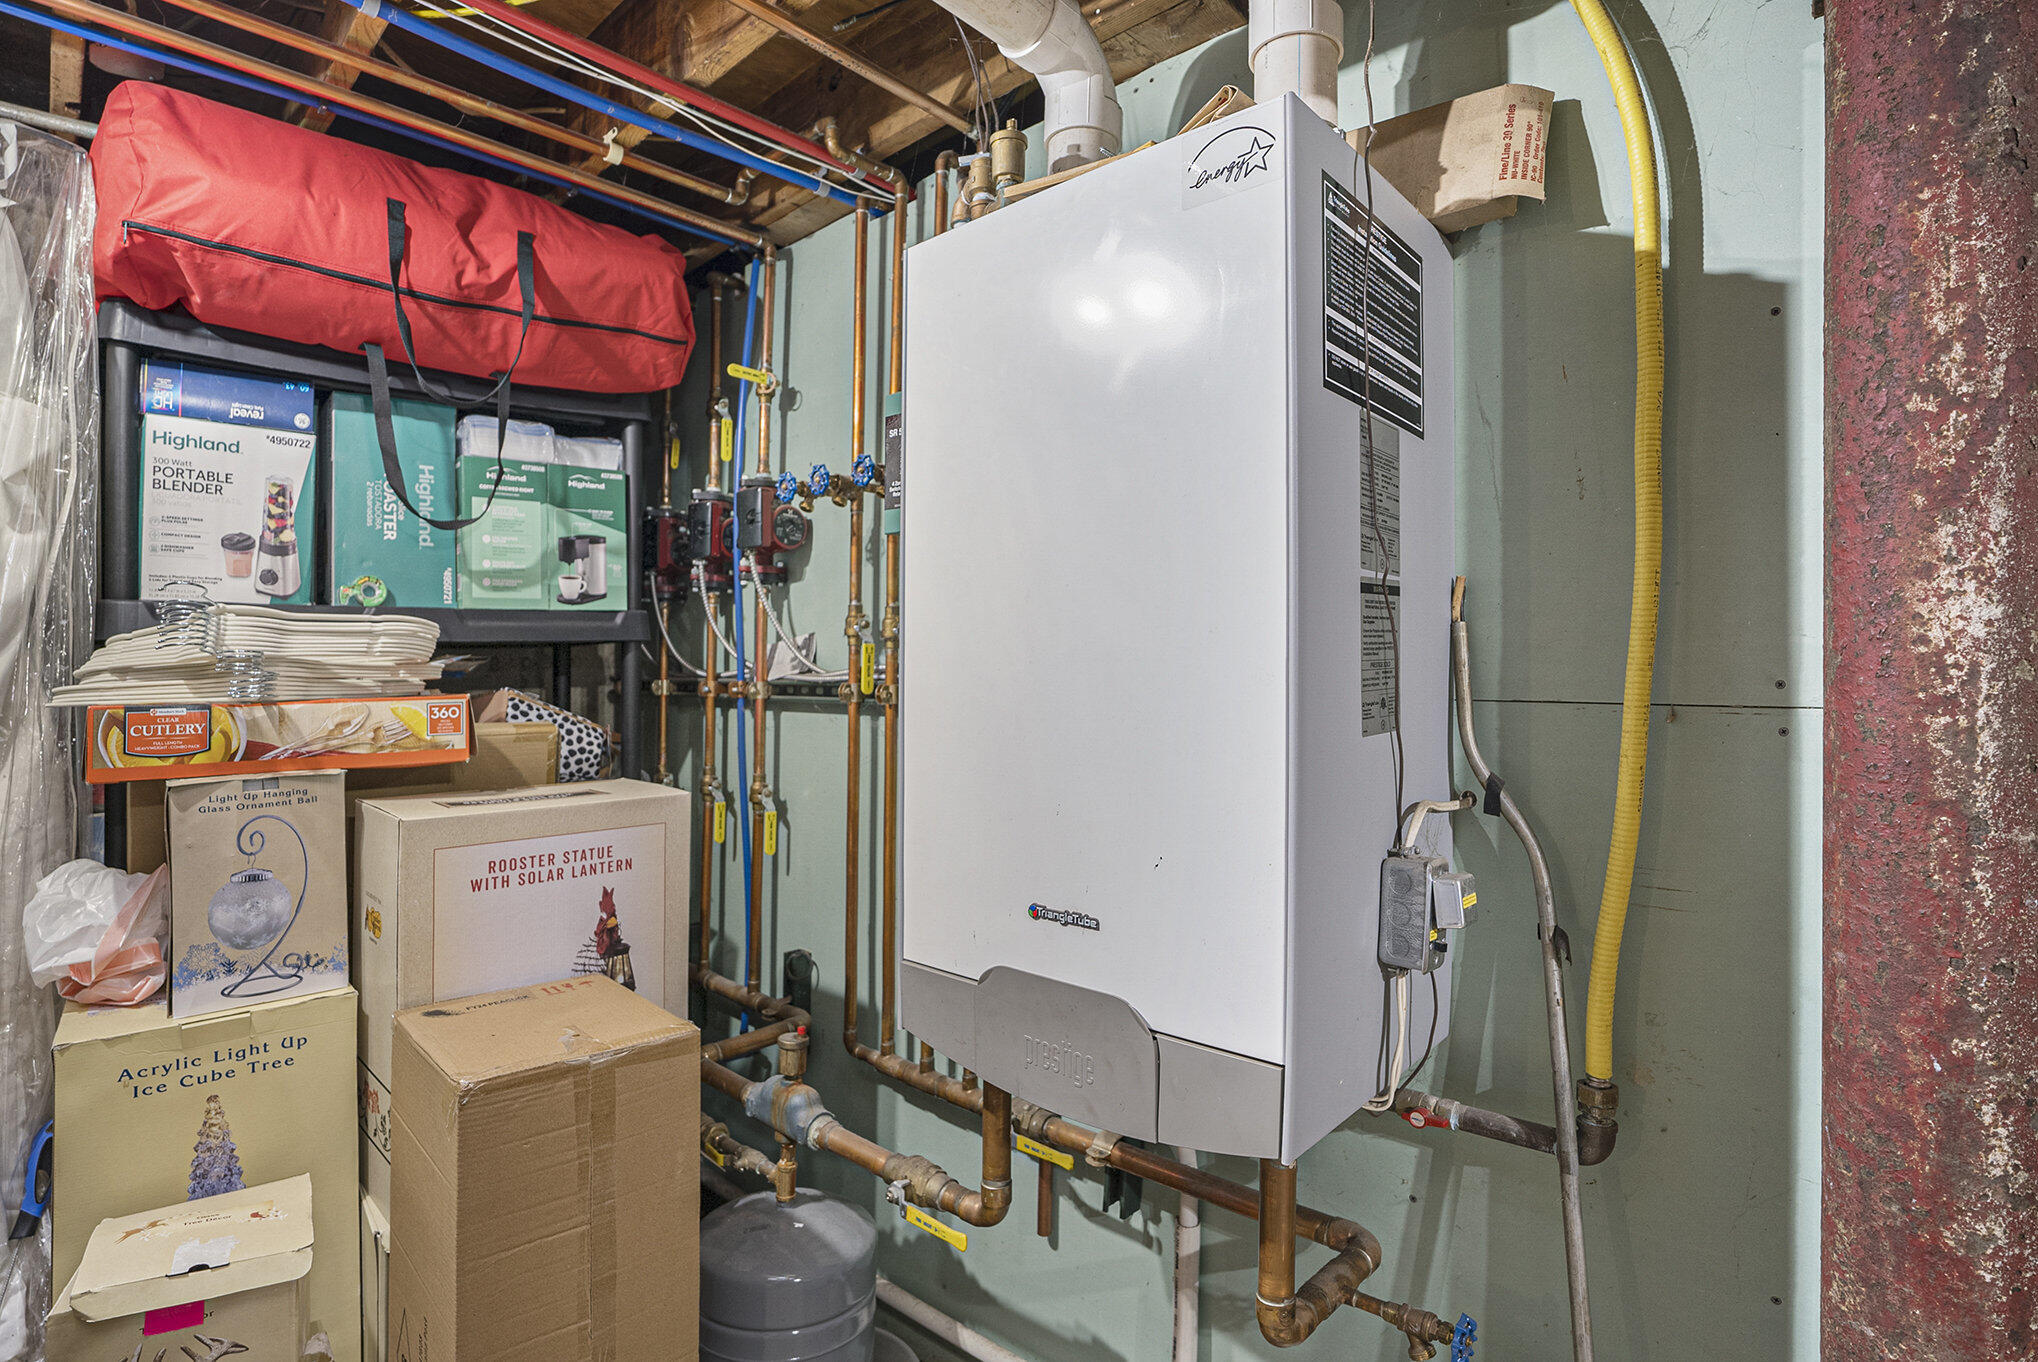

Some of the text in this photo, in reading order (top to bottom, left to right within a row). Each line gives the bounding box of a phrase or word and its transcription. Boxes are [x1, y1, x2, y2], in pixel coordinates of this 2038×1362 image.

[1505, 103, 1517, 129] Series
[1523, 133, 1533, 157] CORNER
[1511, 151, 1521, 180] NU-WHITE
[1521, 159, 1530, 180] INSIDE
[230, 406, 265, 420] reveal
[152, 430, 241, 454] Highland
[152, 457, 193, 467] 300 Watt
[152, 465, 234, 485] PORTABLE
[568, 479, 606, 490] Highland
[152, 478, 224, 496] BLENDER
[383, 472, 397, 541] OASTER
[415, 464, 434, 548] Highland
[430, 706, 460, 720] 360
[129, 723, 206, 737] CUTLERY
[198, 795, 318, 814] Glass Ornament Ball
[208, 788, 308, 804] Light Up Hanging
[488, 845, 613, 875] ROOSTER STATUE
[470, 857, 633, 893] WITH SOLAR LANTERN
[1036, 906, 1097, 928] TriangleTube
[117, 1036, 308, 1083] Acrylic Light Up
[1024, 1034, 1095, 1089] prestige
[132, 1057, 295, 1099] Ice Cube Tree
